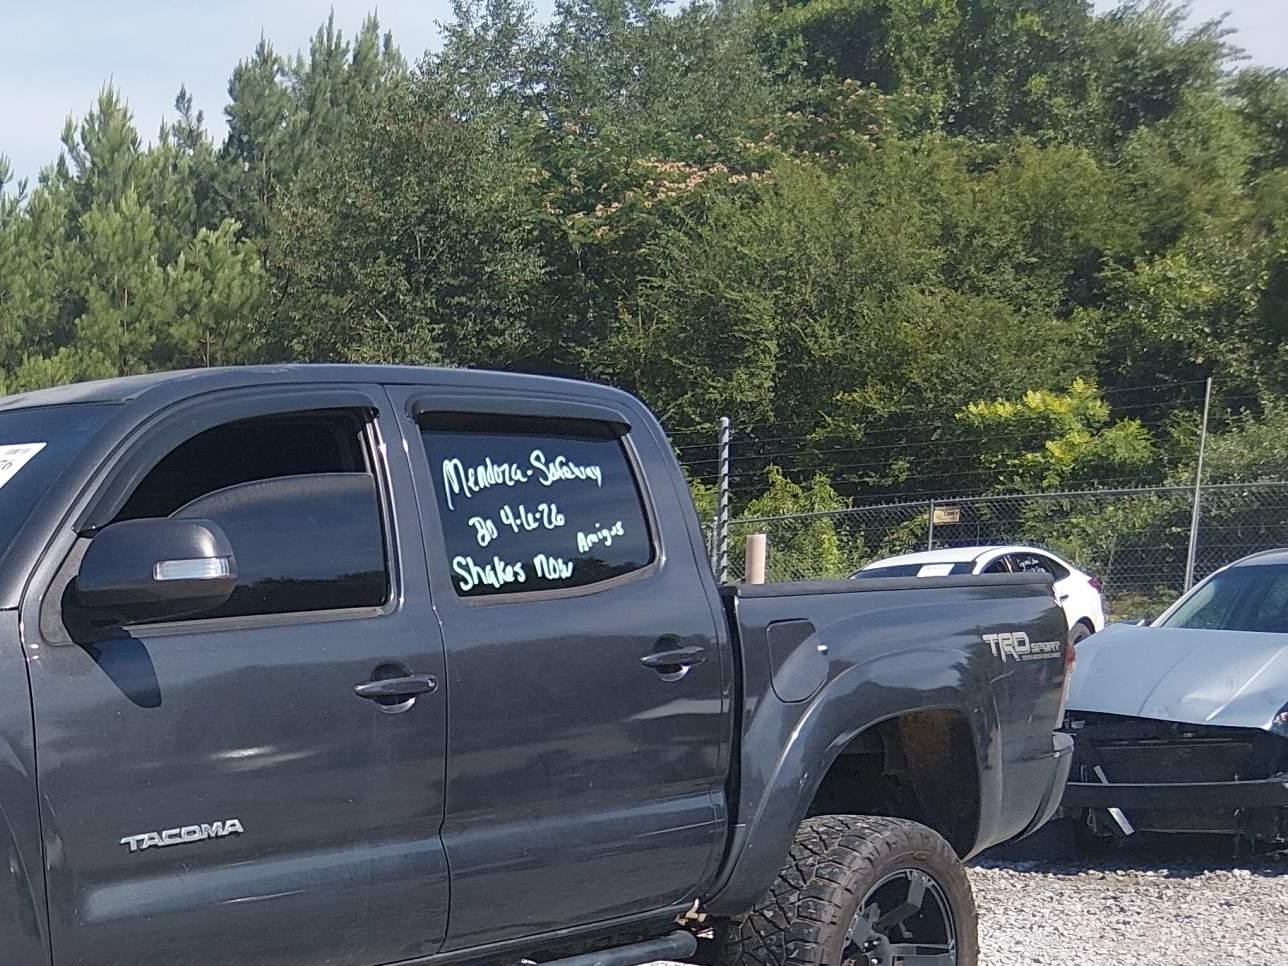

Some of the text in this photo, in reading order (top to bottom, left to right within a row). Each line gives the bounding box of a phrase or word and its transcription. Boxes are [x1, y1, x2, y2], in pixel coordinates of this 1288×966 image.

[452, 555, 526, 591] Shakes
[982, 631, 1061, 663] TRD SPORT
[120, 818, 245, 852] TACOMA
